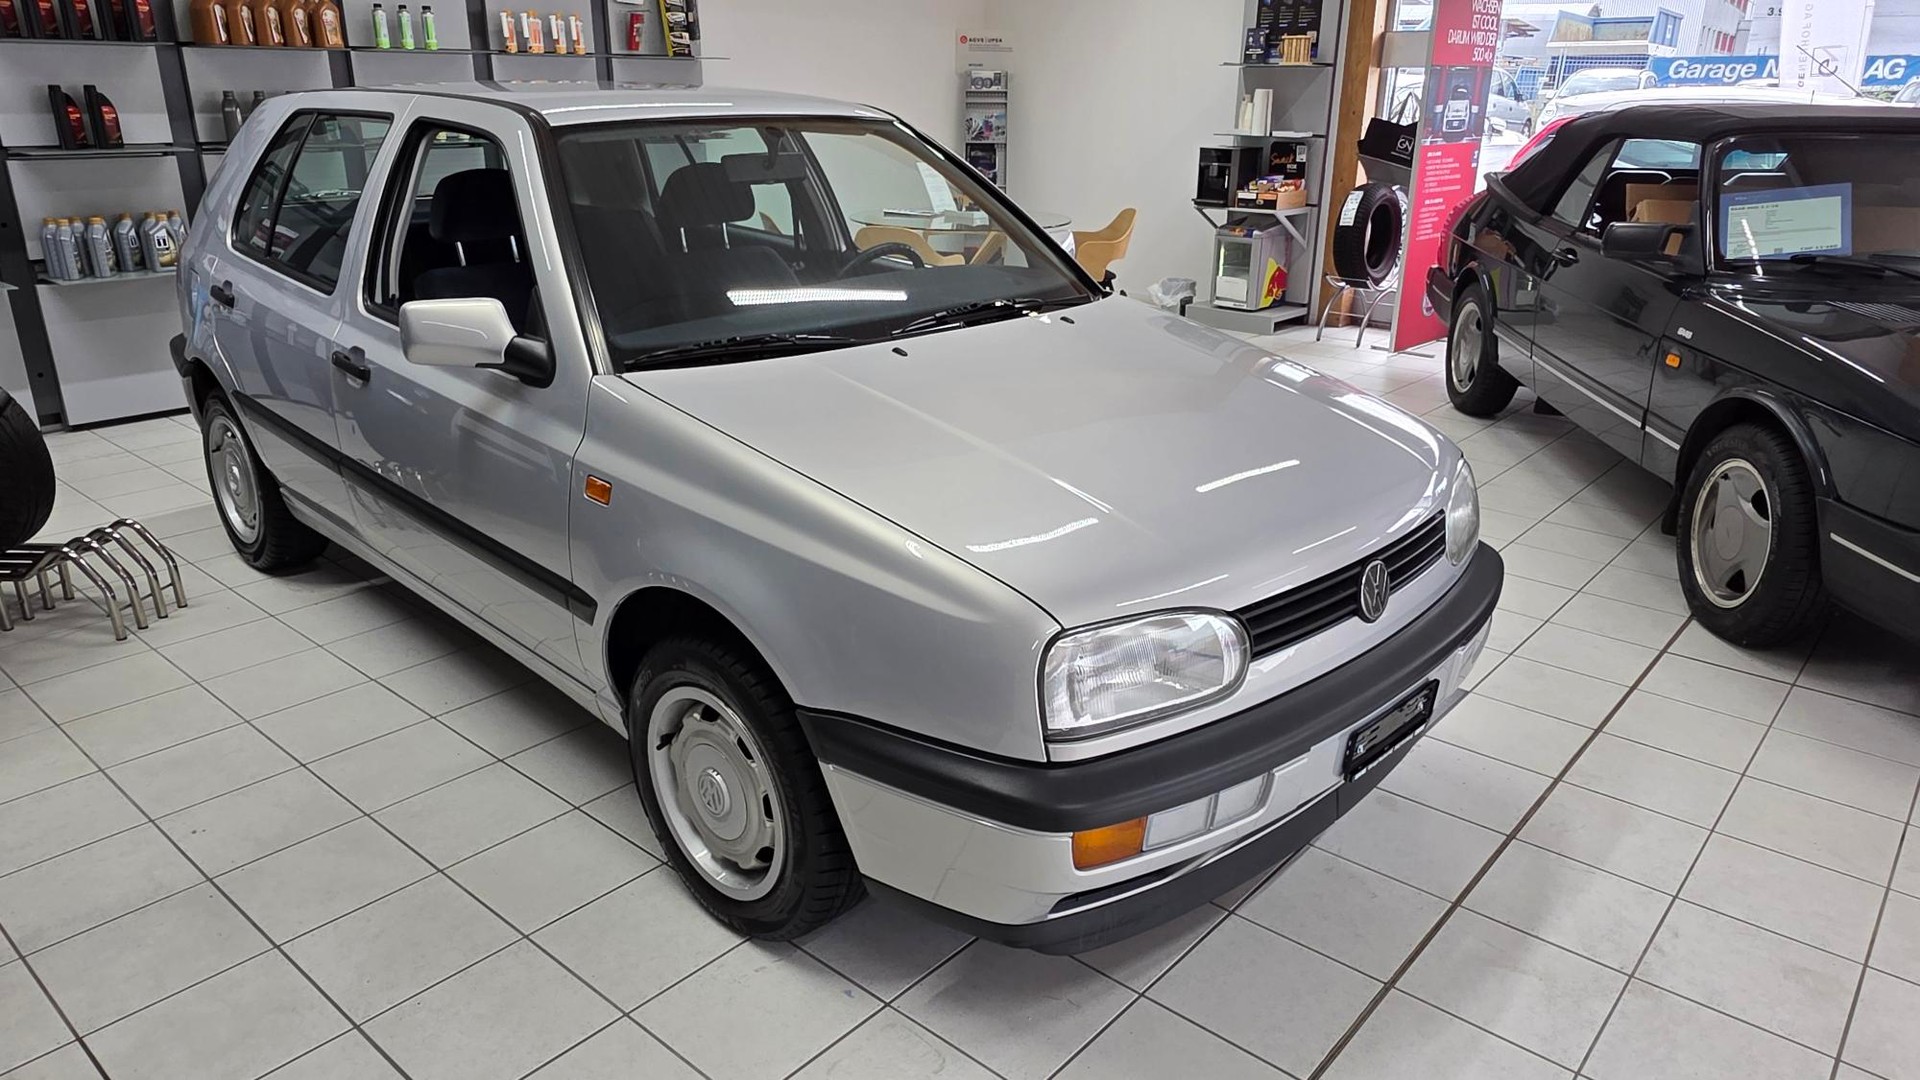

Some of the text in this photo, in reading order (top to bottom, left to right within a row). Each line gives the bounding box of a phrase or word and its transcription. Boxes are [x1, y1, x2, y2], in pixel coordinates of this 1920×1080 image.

[1472, 0, 1502, 14] WACHSEN
[1472, 15, 1481, 29] IST
[1447, 29, 1497, 47] DARUM WIRD DER
[1472, 47, 1485, 62] 500
[1668, 57, 1908, 85] Garage N AG
